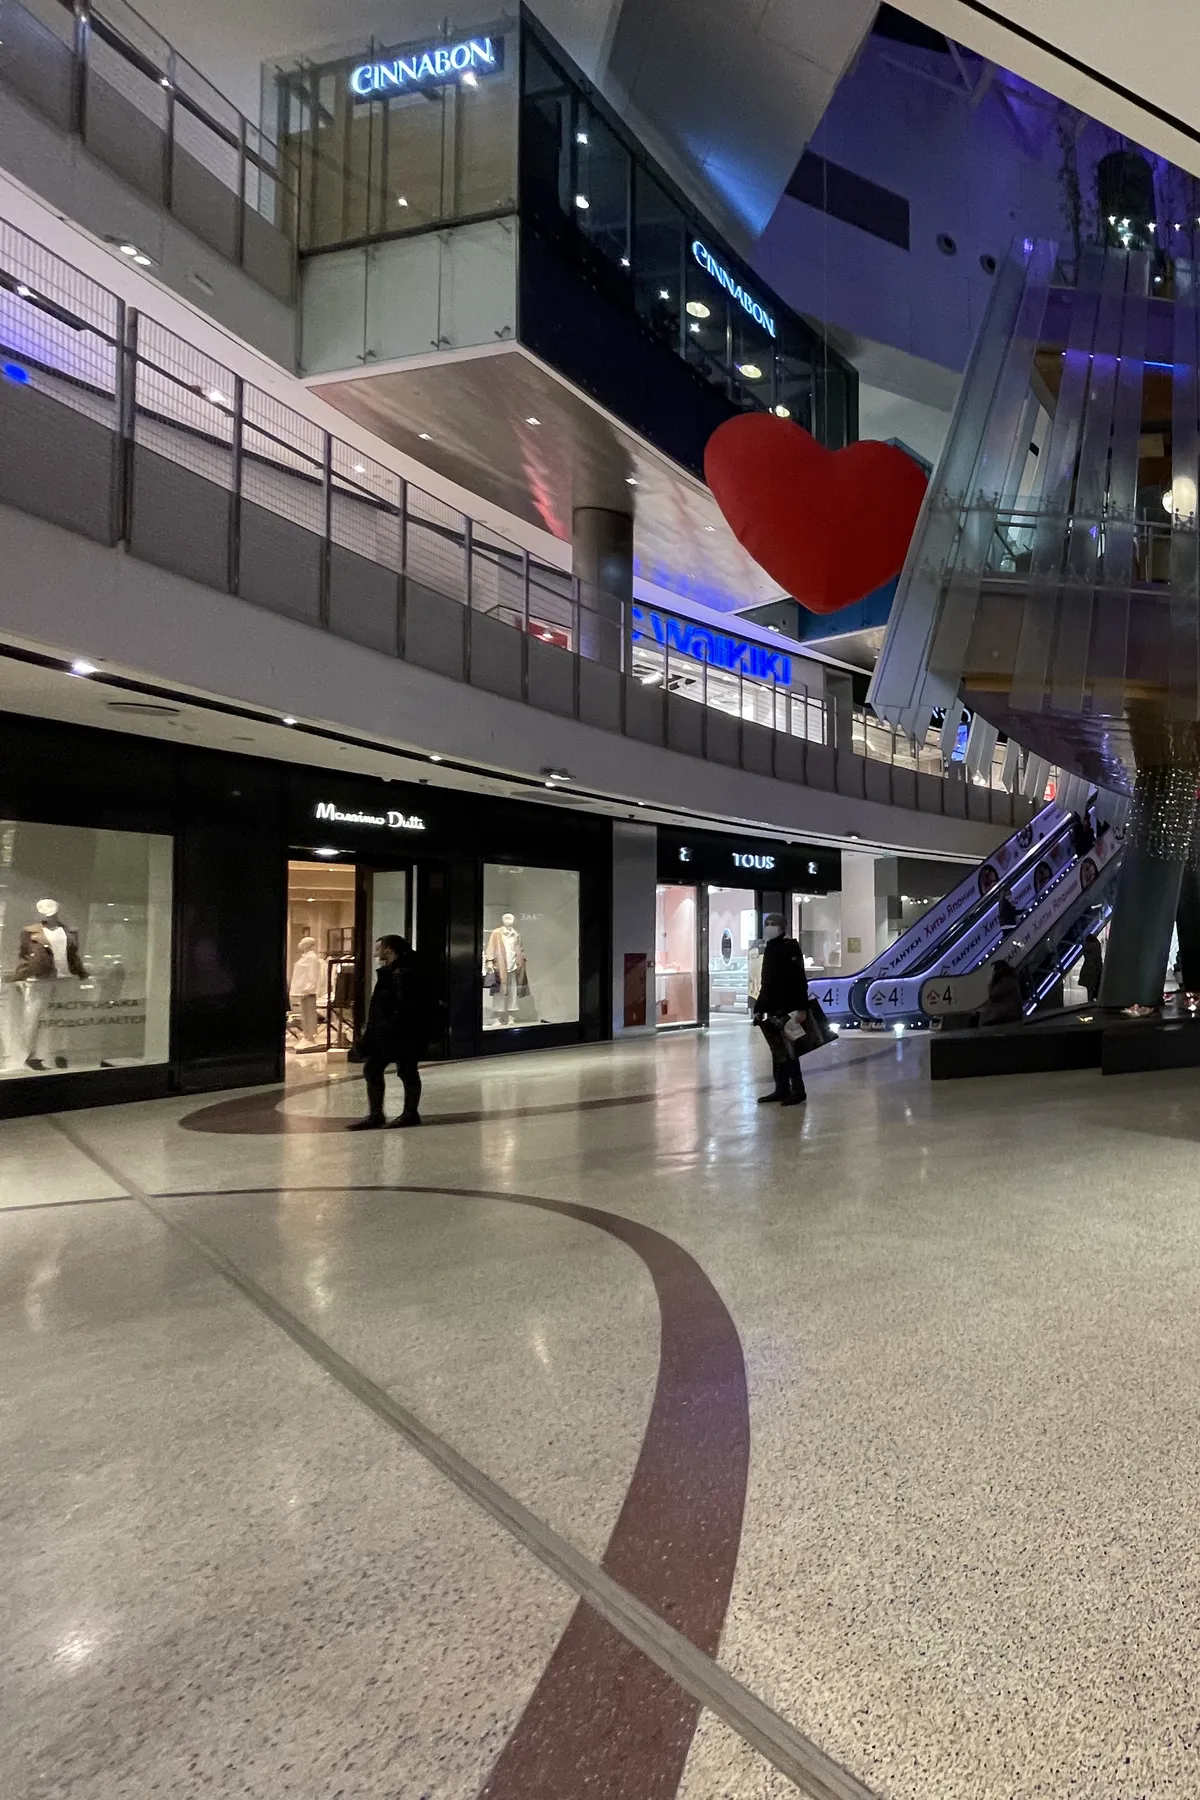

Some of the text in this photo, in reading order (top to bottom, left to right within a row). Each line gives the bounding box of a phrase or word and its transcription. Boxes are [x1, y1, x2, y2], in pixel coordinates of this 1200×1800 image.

[351, 37, 492, 94] CINNABON
[692, 240, 776, 338] CINNABON
[315, 802, 426, 830] Massimo Dutti
[732, 852, 776, 870] TOUS
[889, 885, 976, 967] ТАНУКИ Хиты Японии
[951, 936, 982, 967] ТАНУКИ
[822, 987, 834, 1007] 4
[887, 986, 899, 1007] 4
[942, 985, 953, 1006] 4
